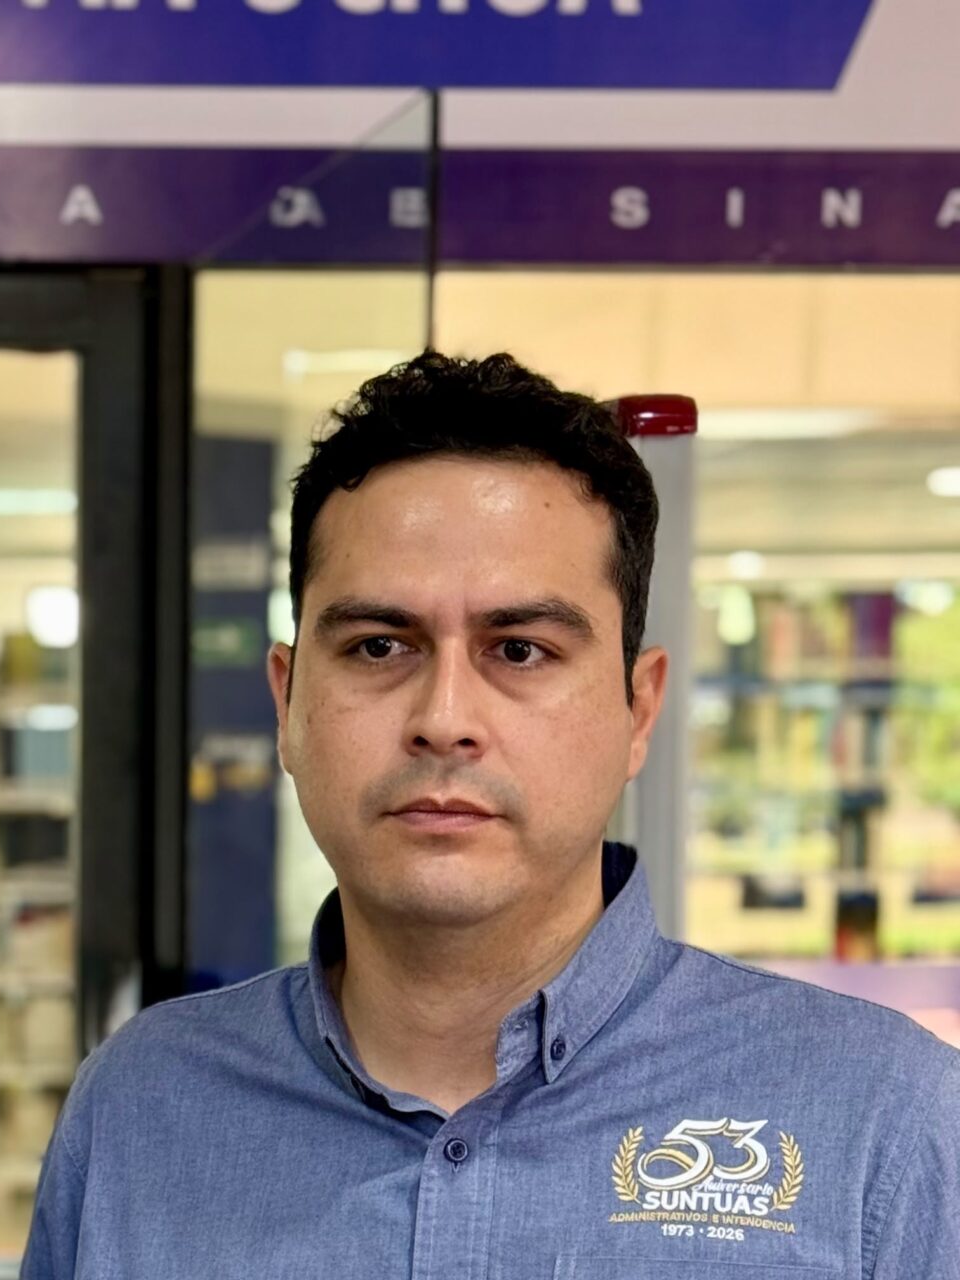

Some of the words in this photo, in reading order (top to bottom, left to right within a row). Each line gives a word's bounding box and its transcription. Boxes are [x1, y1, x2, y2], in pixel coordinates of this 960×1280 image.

[637, 1117, 770, 1190] 53
[692, 1175, 774, 1195] Aniversario
[642, 1190, 770, 1216] SUNTUAS
[608, 1211, 708, 1223] ADMINISTRATIVOS
[712, 1214, 720, 1223] E
[722, 1214, 796, 1233] INTENDENCIA
[661, 1223, 695, 1237] 1973
[706, 1226, 745, 1240] 2026
